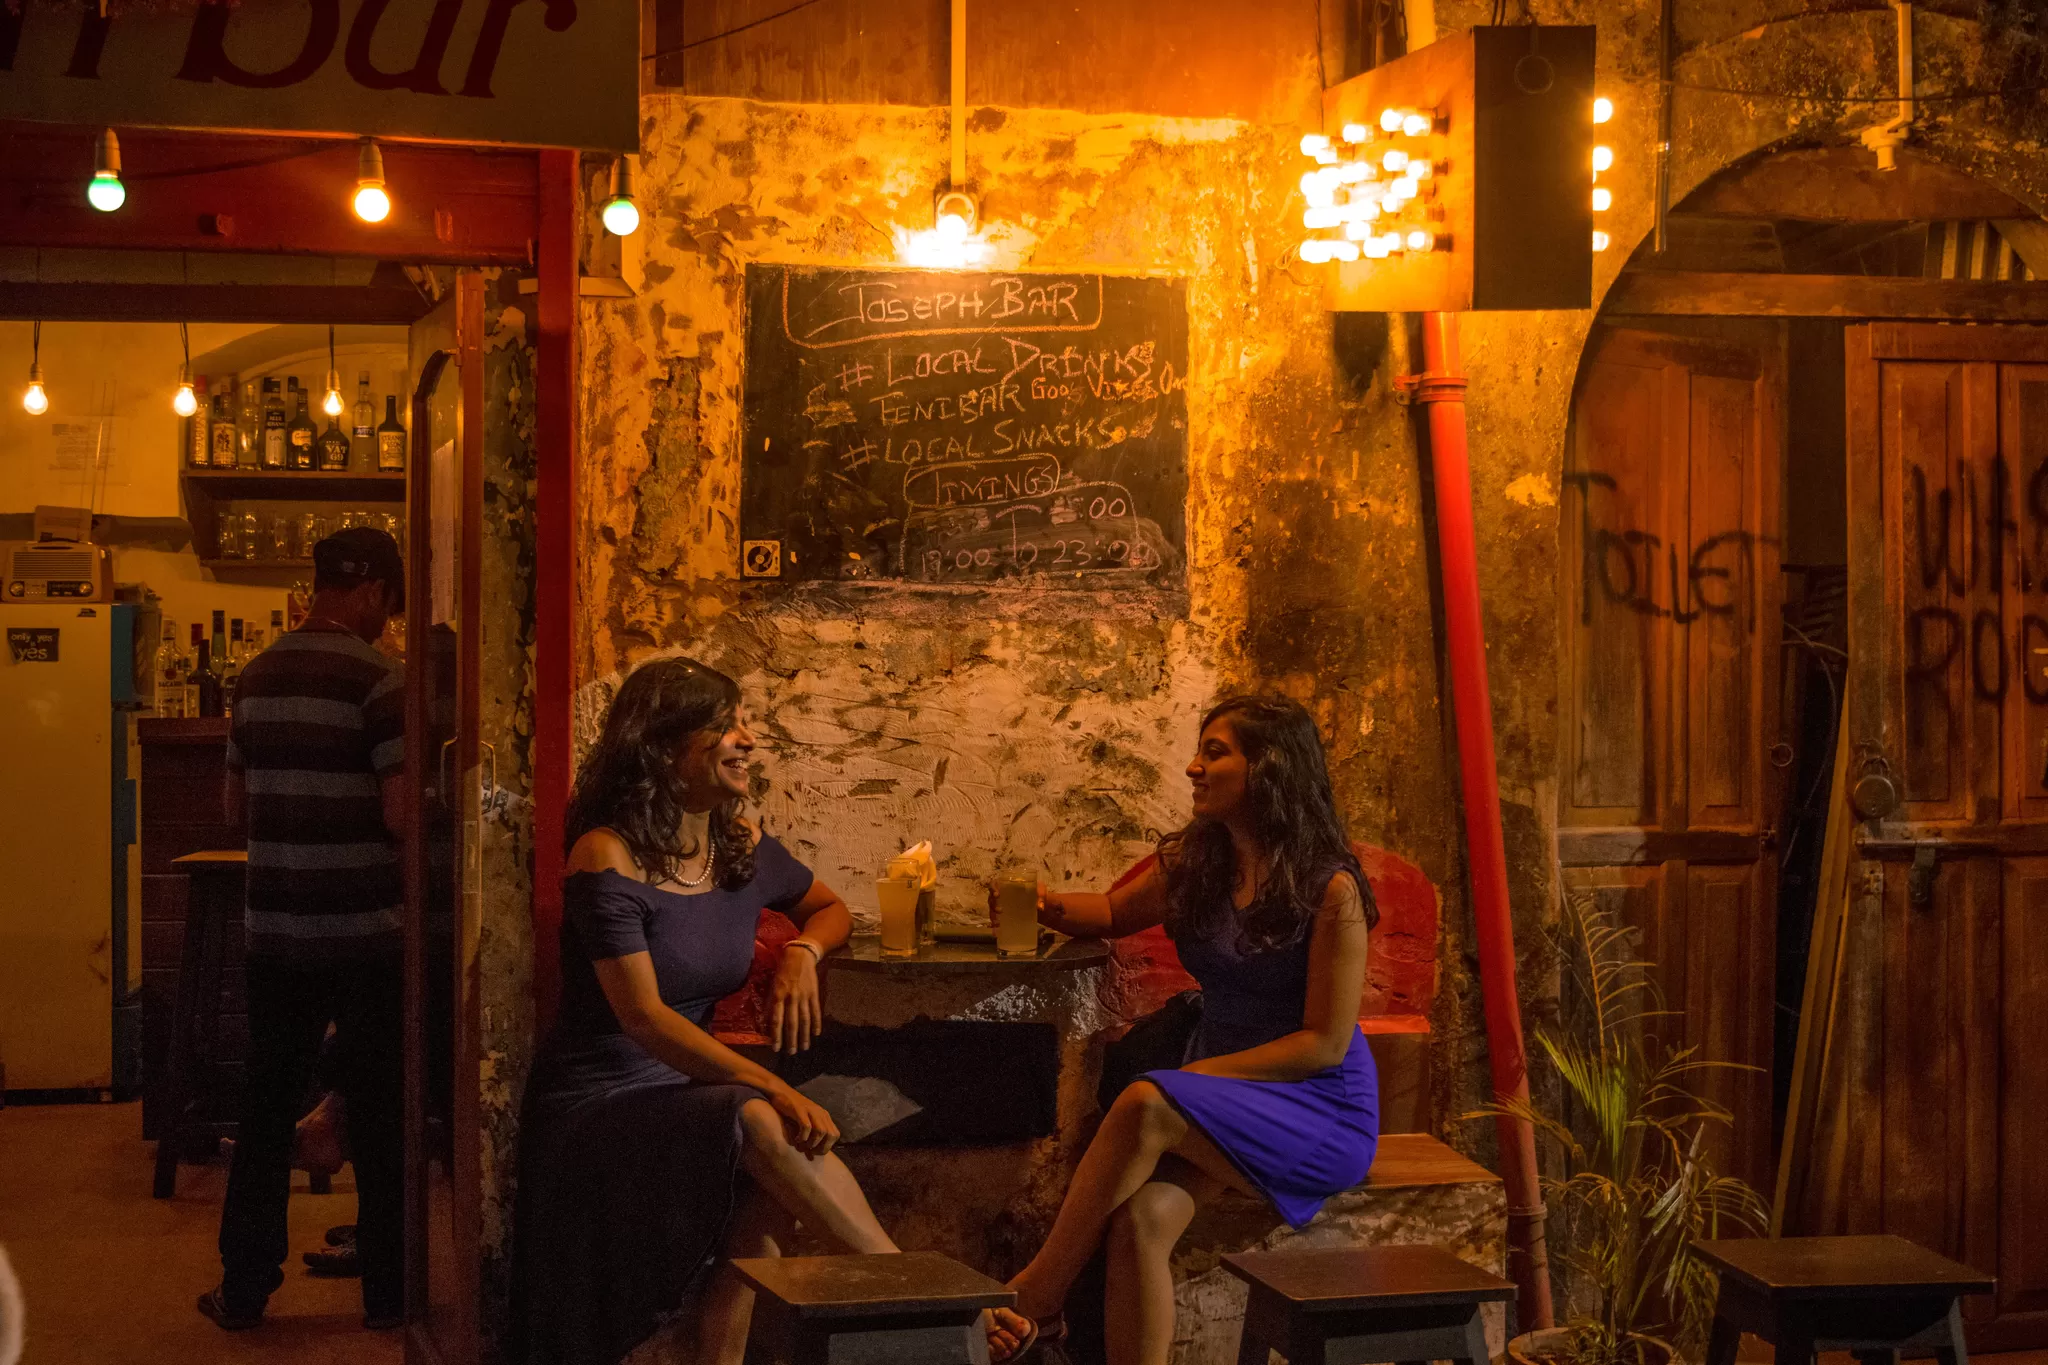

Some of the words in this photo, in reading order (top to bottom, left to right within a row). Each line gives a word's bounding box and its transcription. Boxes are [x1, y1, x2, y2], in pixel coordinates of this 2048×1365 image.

[990, 277, 1079, 323] BAR
[1000, 336, 1156, 386] DRINKS
[993, 415, 1128, 455] SNACKS
[11, 632, 31, 643] only
[37, 634, 53, 643] yes
[18, 647, 48, 661] yes
